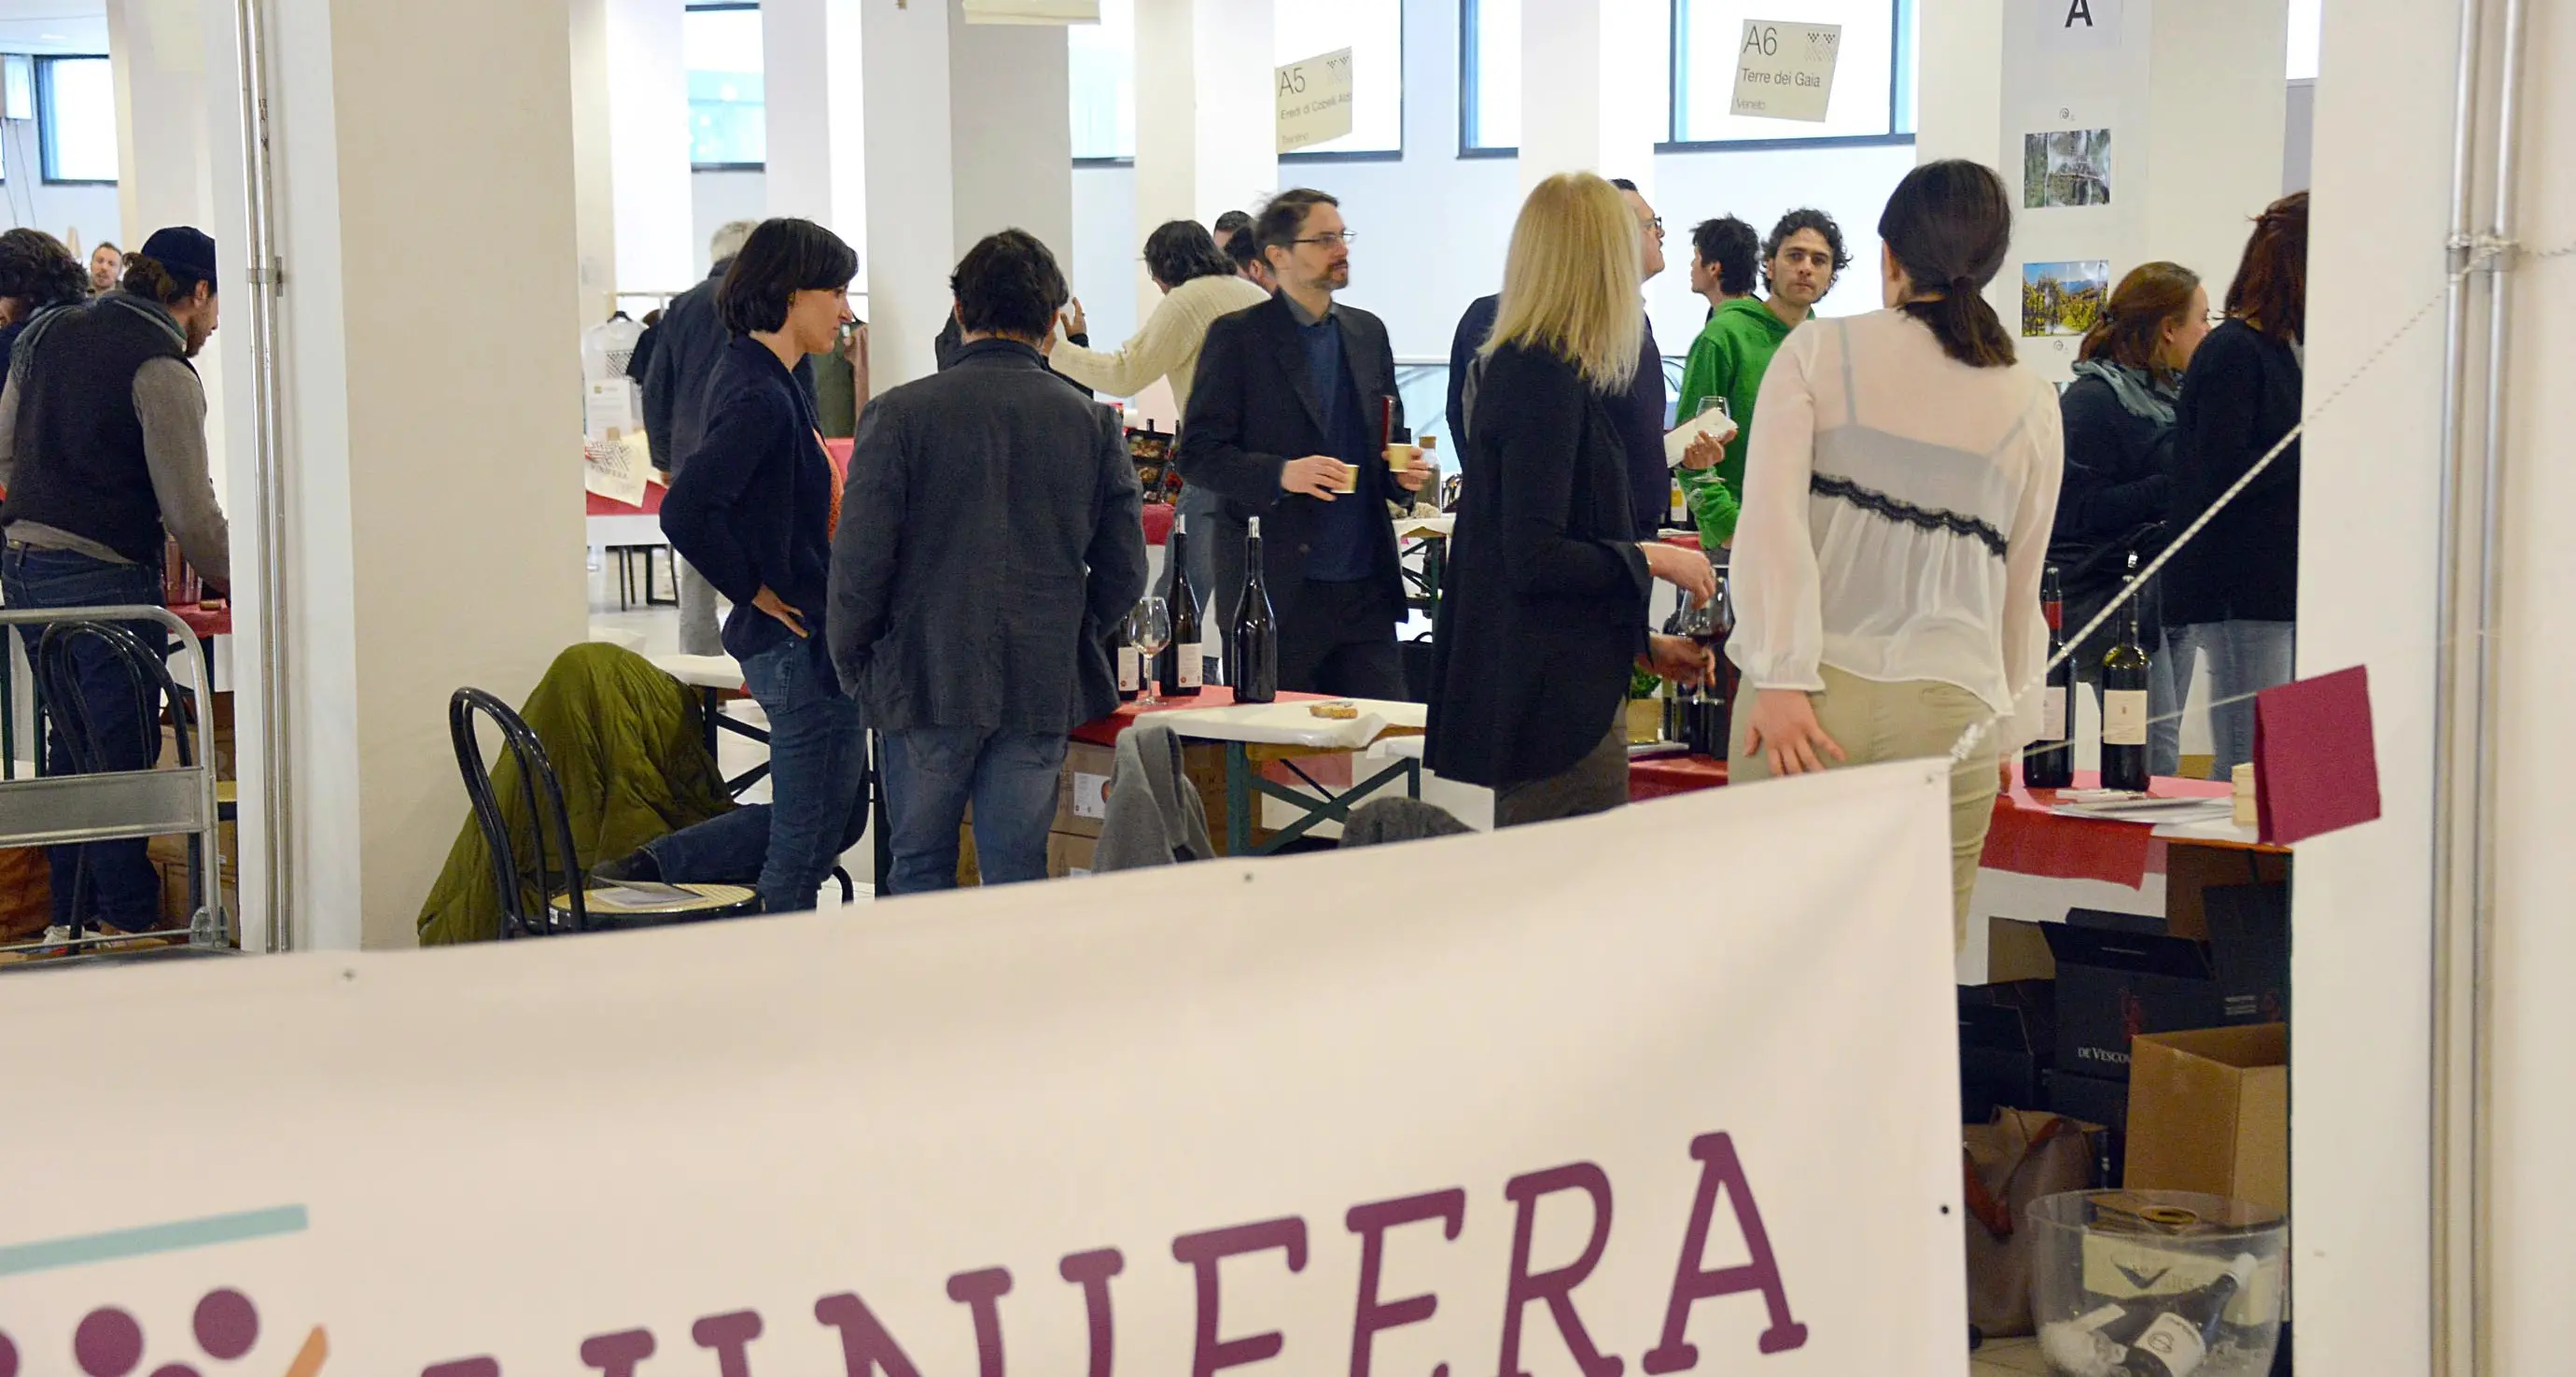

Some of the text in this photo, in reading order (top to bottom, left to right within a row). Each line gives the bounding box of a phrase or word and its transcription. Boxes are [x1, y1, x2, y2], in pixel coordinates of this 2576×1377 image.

[2065, 0, 2093, 27] A
[1743, 24, 1777, 56] A6
[1279, 67, 1306, 97] A5
[1742, 68, 1821, 88] Terre dei Gaia
[421, 1131, 1809, 1377] IFERA
